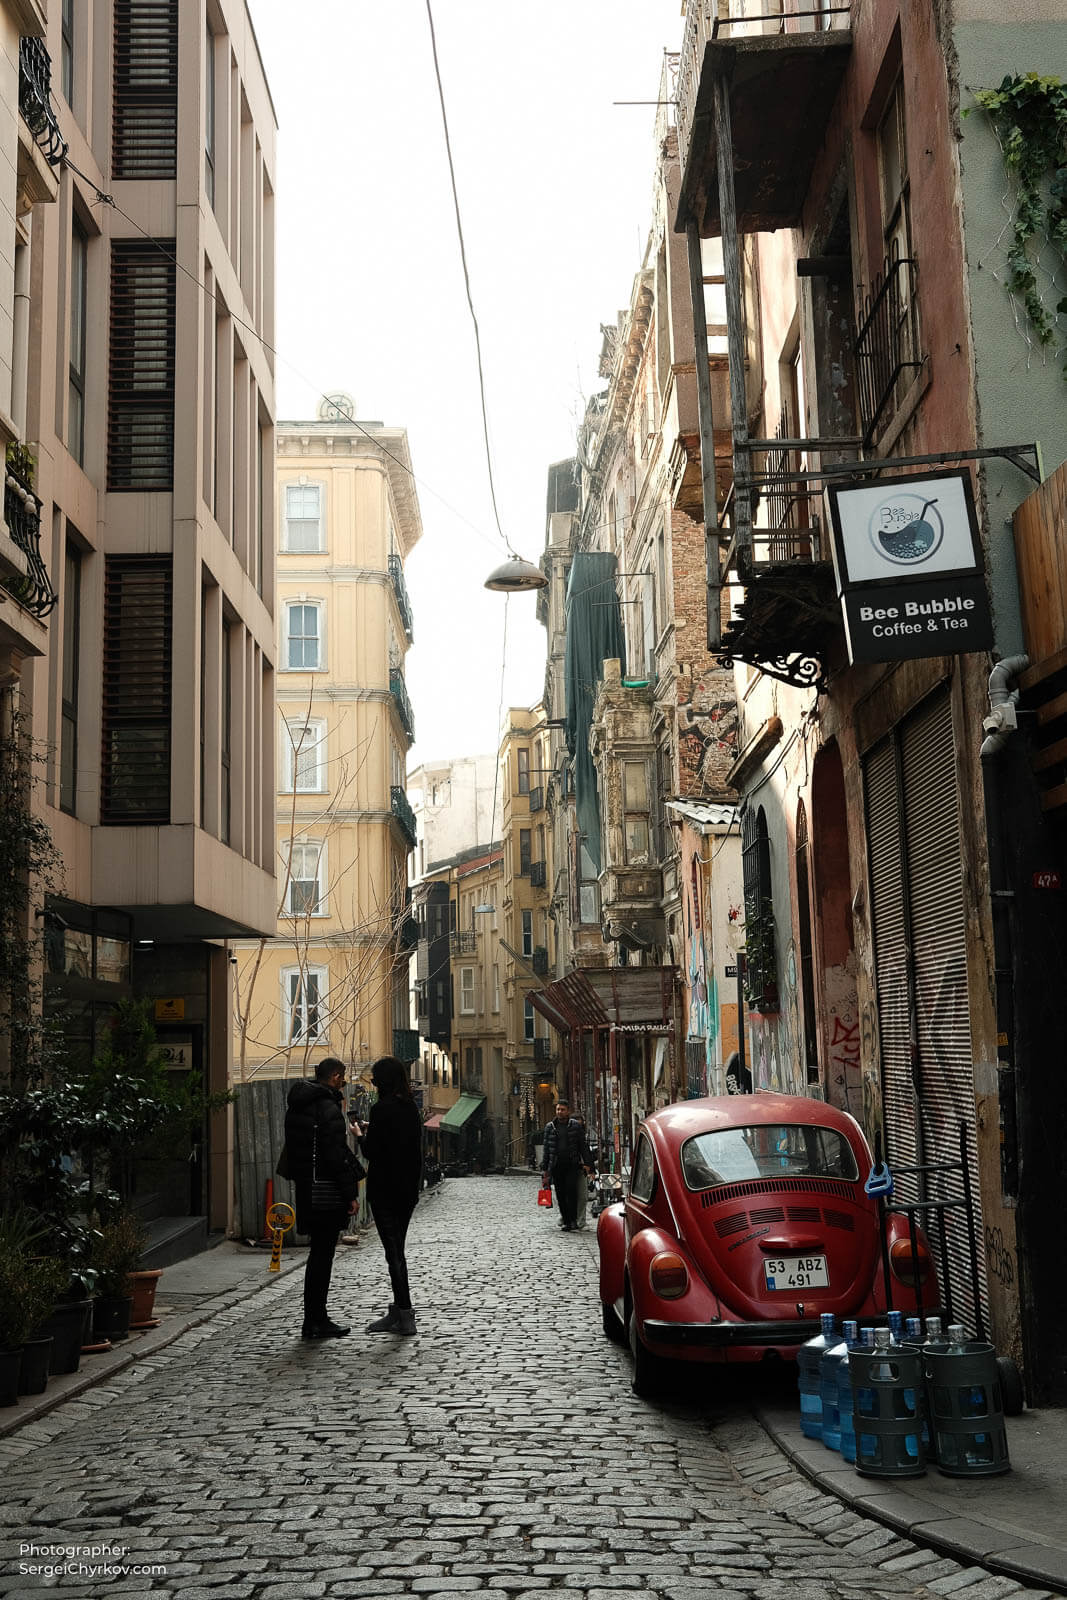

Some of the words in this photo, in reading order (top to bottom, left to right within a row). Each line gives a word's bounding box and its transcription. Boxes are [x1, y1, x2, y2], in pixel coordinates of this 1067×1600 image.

[860, 607, 899, 621] Bee
[905, 597, 975, 616] Bubble
[872, 622, 922, 637] Coffee
[927, 619, 939, 631] &
[940, 617, 968, 630] Tea
[768, 1261, 785, 1273] 53
[798, 1259, 822, 1271] ABZ
[788, 1274, 811, 1286] 491
